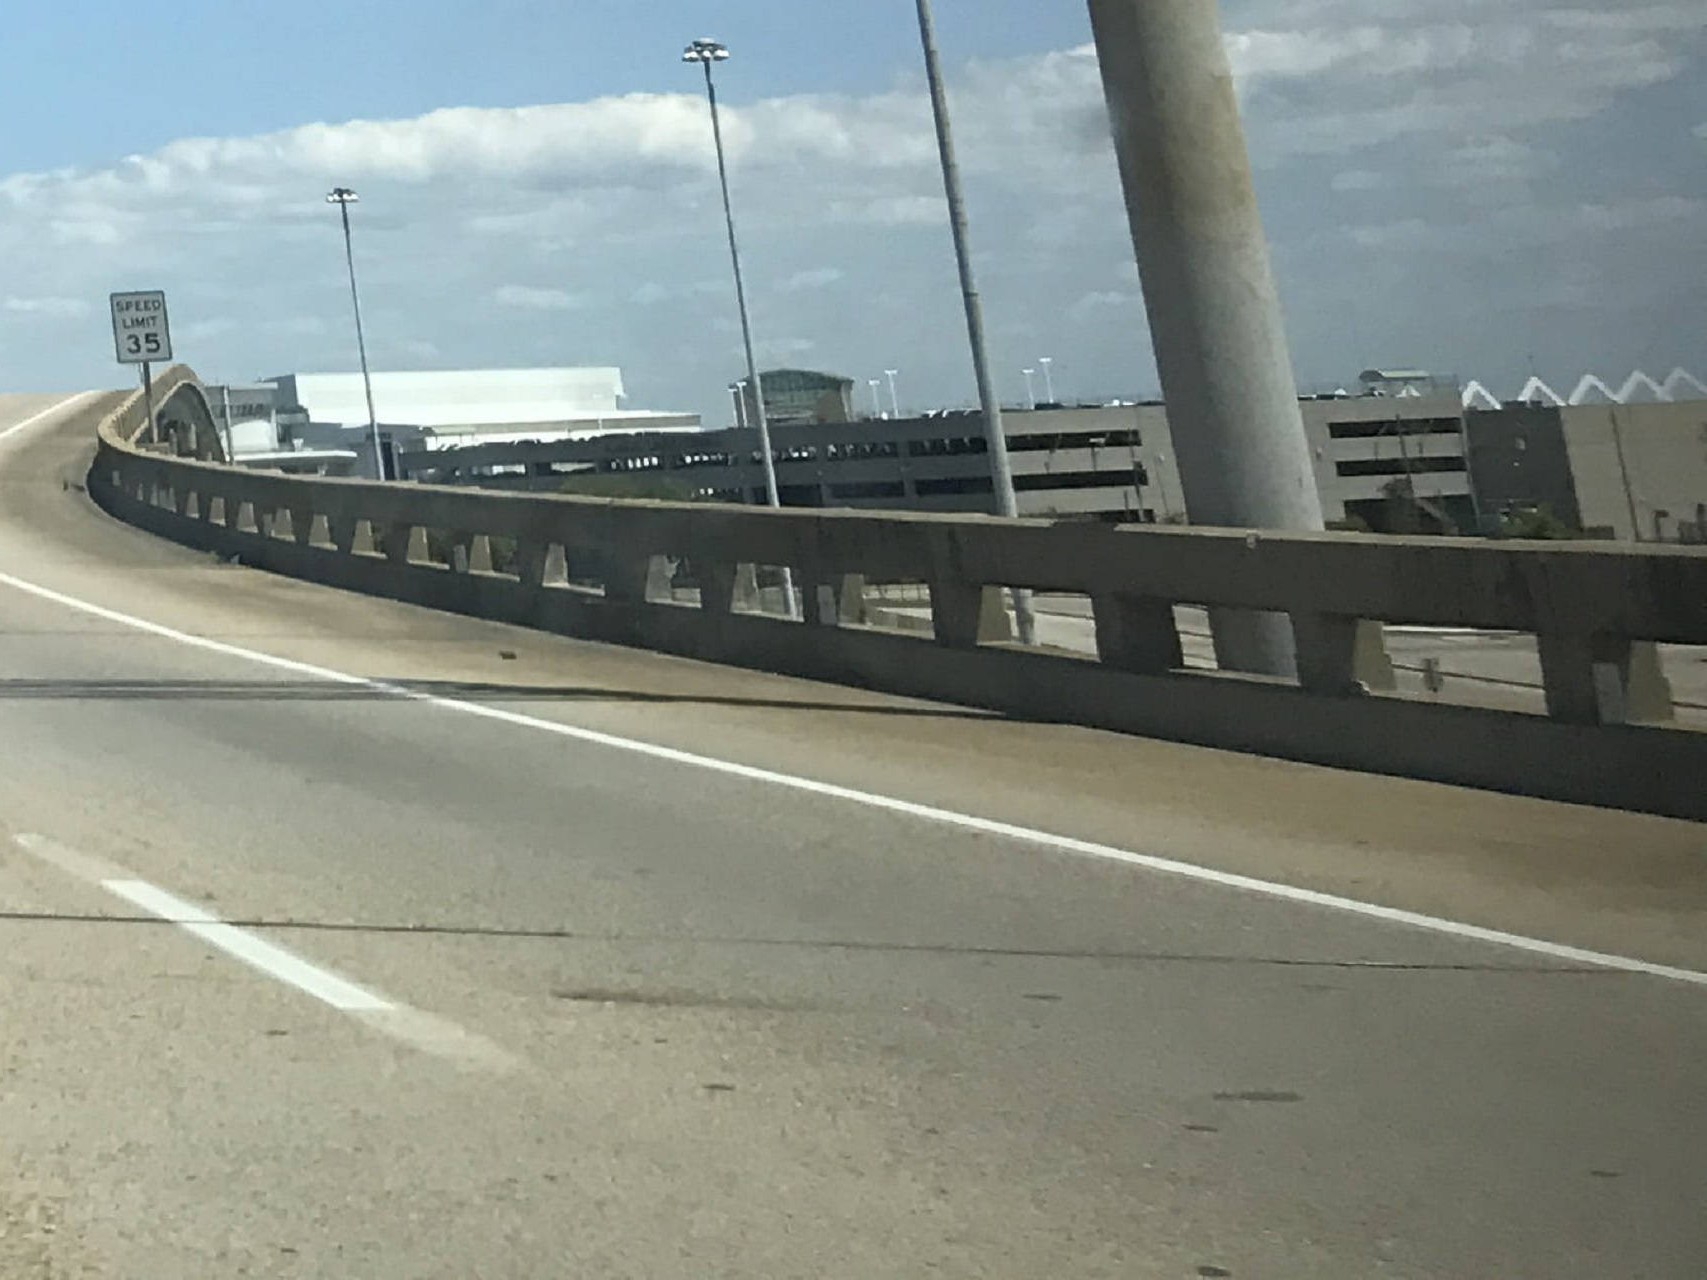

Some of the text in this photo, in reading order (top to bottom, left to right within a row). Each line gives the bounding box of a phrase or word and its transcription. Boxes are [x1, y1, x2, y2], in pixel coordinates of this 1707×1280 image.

[116, 300, 161, 313] SPEED
[122, 315, 157, 329] LIMIT
[126, 332, 160, 354] 35
